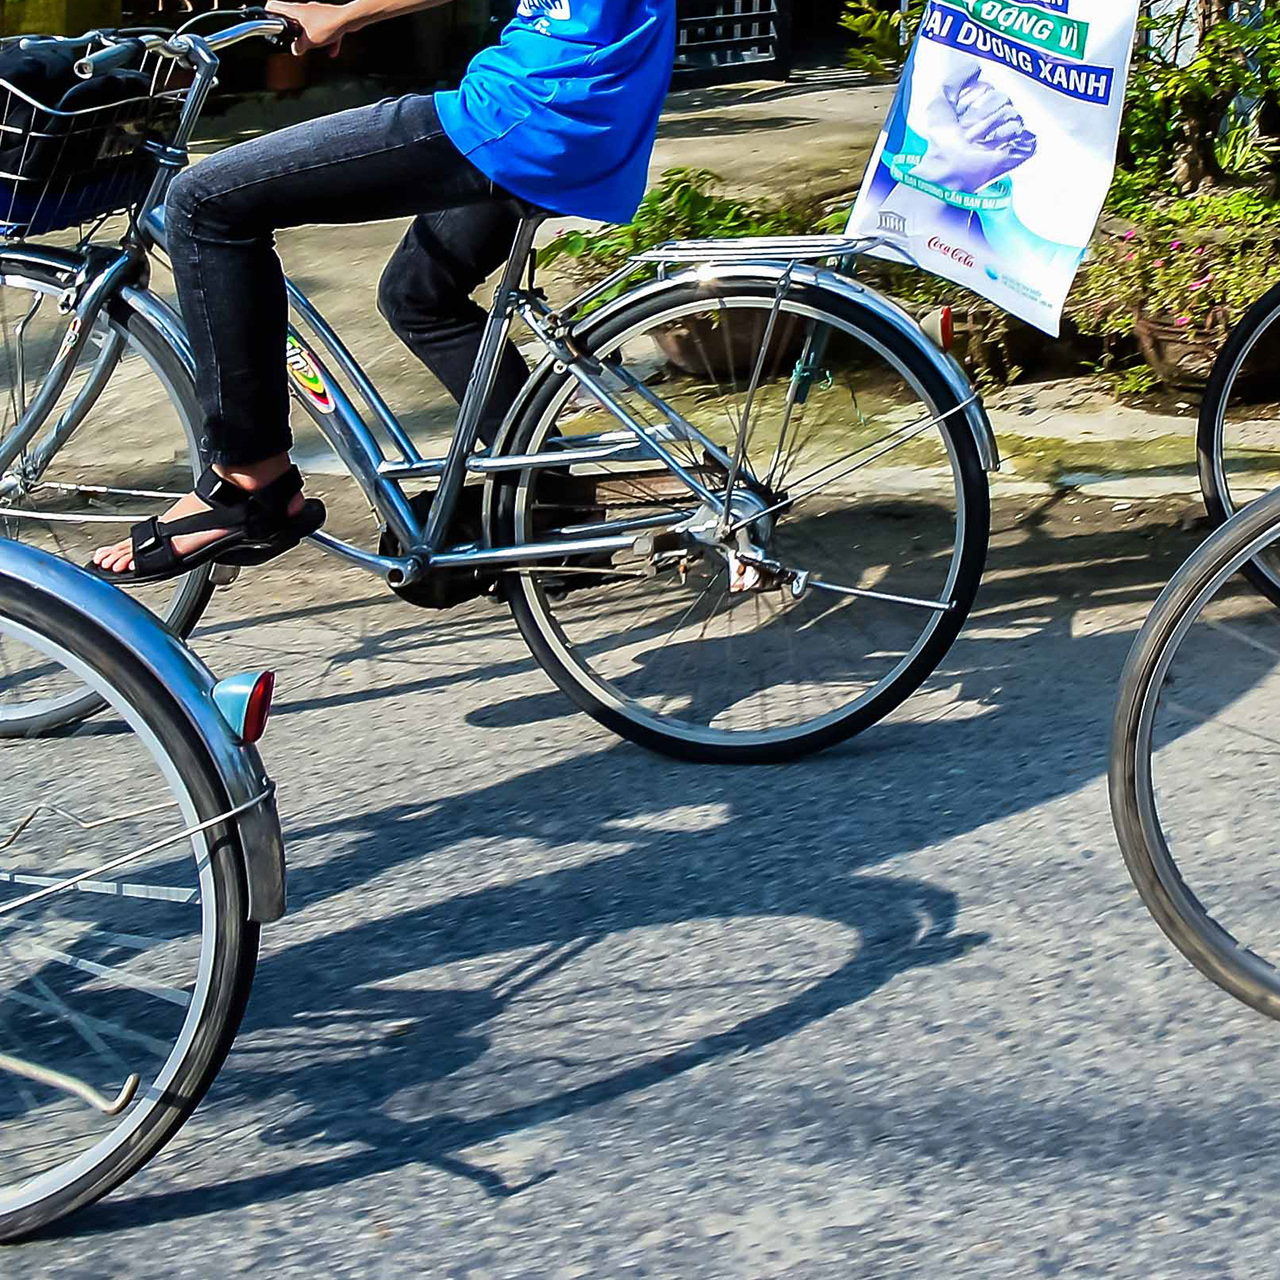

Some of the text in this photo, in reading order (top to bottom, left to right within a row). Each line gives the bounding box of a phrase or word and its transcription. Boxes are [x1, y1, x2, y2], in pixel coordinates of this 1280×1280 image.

[980, 0, 1055, 42] ĐỘNG
[1059, 22, 1079, 52] VÌ
[1037, 58, 1108, 98] XANH
